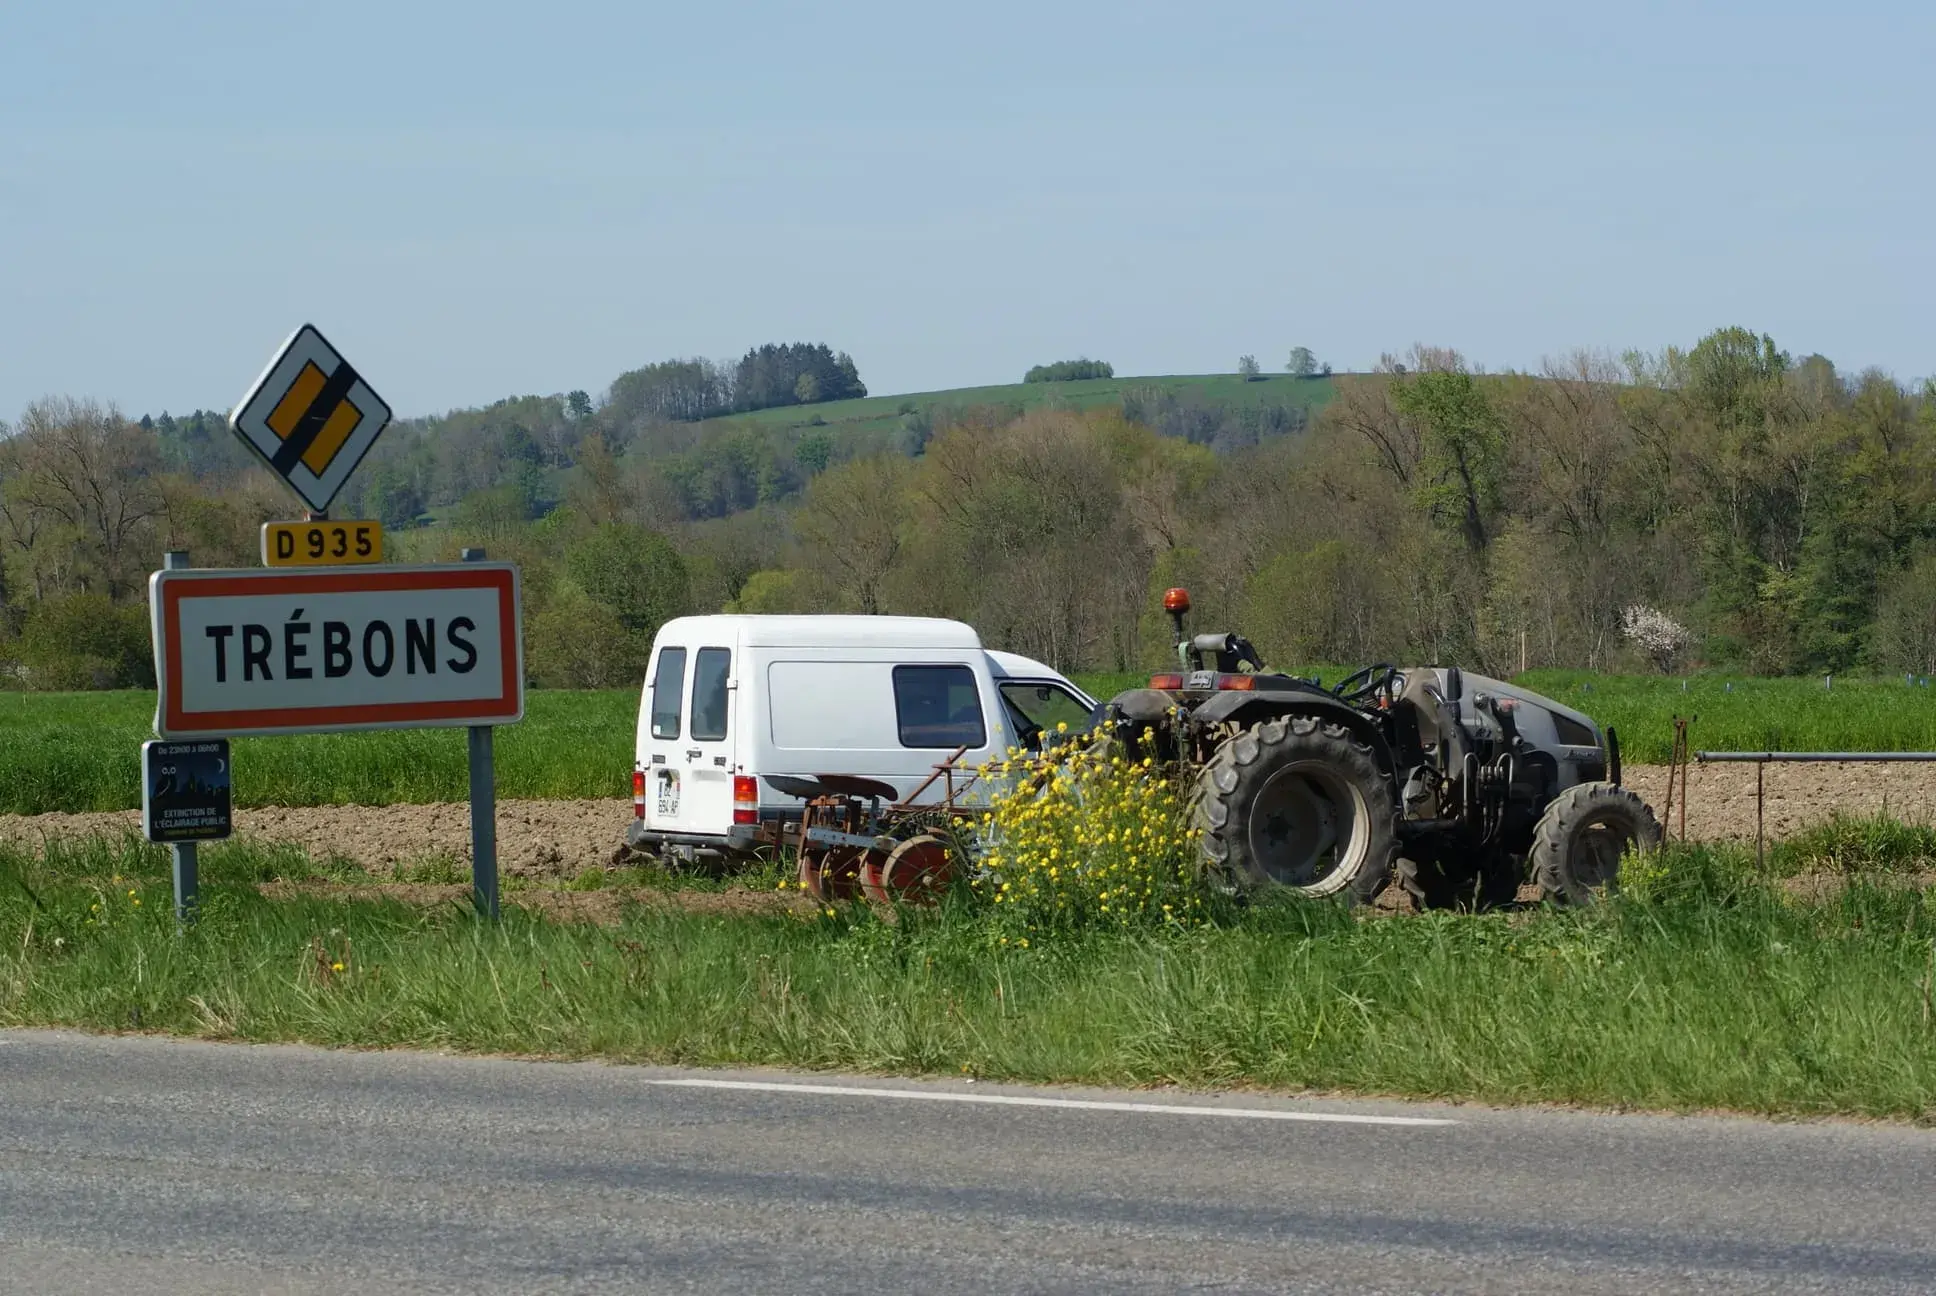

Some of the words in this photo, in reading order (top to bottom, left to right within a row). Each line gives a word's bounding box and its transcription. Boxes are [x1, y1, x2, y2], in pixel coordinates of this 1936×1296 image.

[276, 530, 295, 559] D
[307, 527, 373, 558] 935
[205, 608, 478, 683] TRÉBONS
[164, 808, 205, 818] EXTINCTION
[200, 816, 226, 825] PUBLIC
